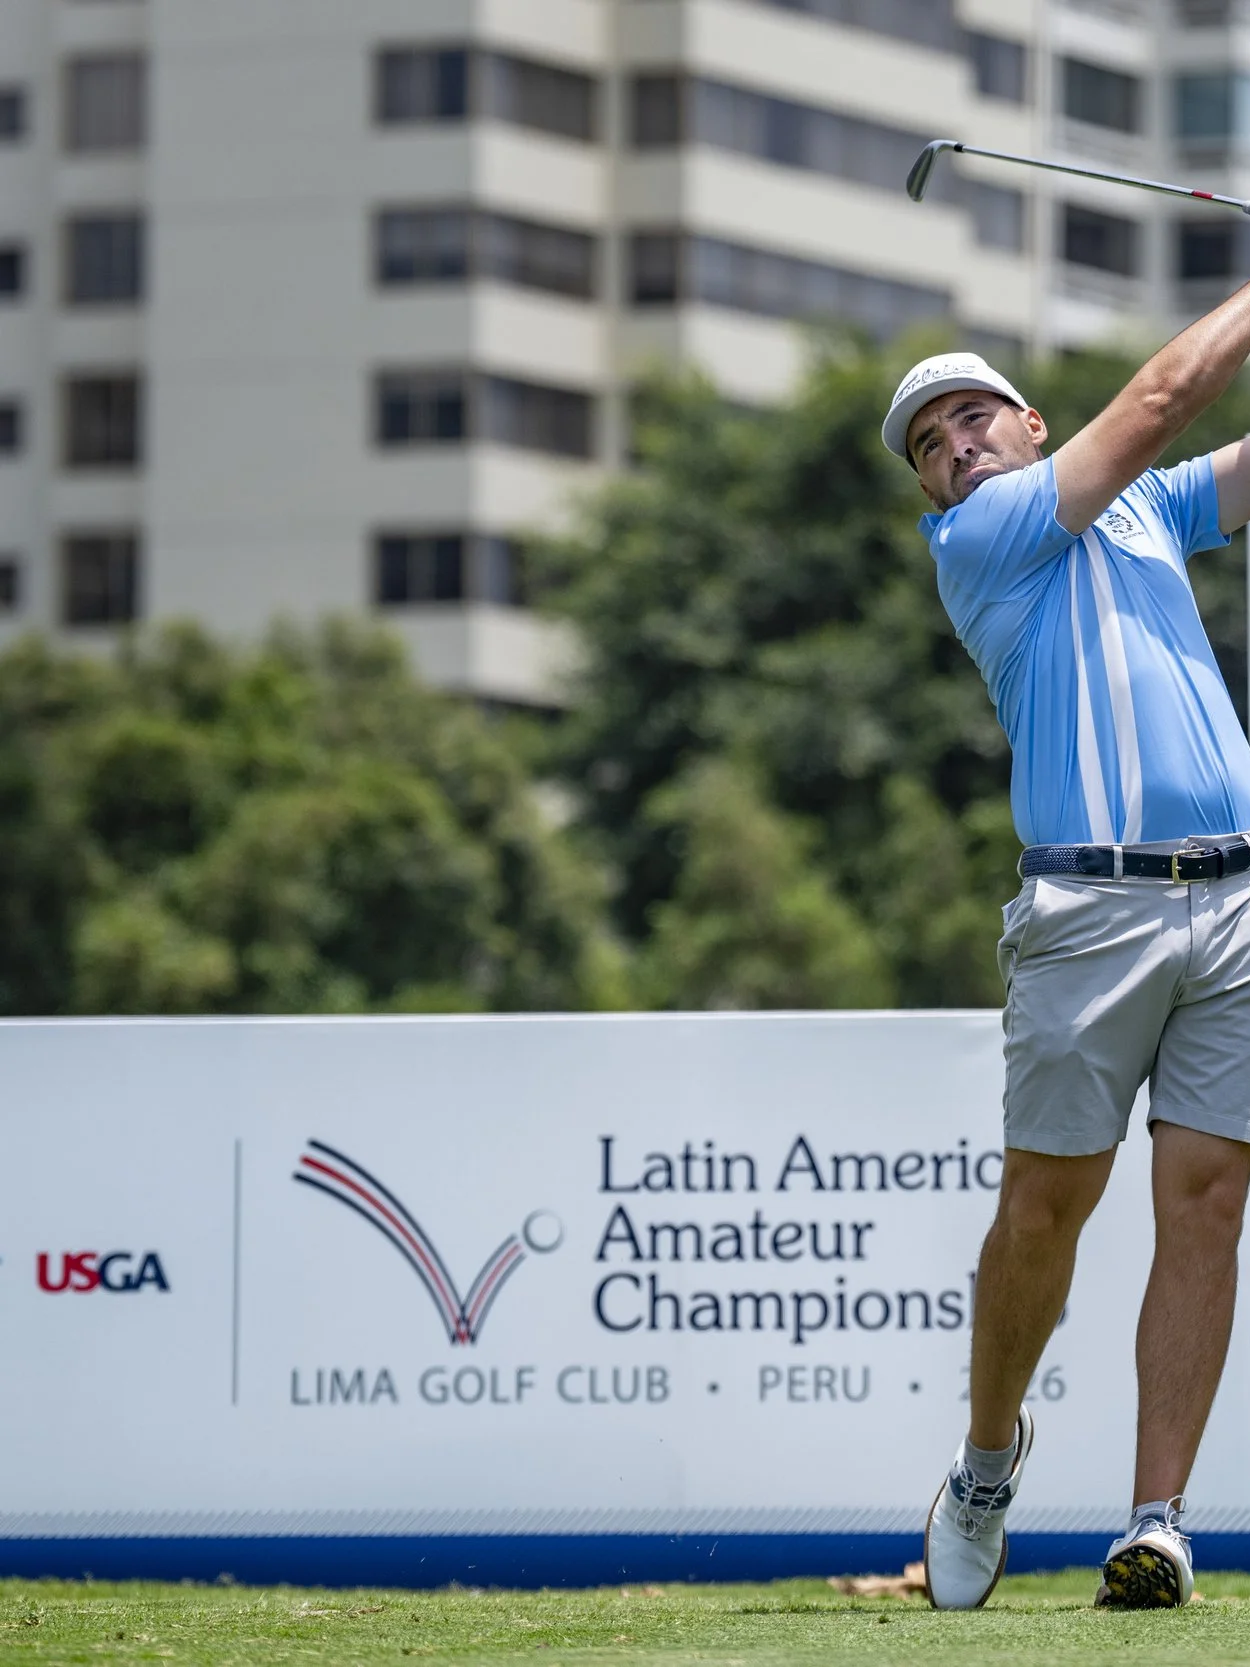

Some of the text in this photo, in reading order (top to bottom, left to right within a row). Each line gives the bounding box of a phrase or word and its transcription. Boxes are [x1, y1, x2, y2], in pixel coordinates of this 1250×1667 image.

[598, 1135, 1003, 1193] Latin Americ
[595, 1204, 875, 1262] Amateur
[36, 1252, 170, 1293] USGA
[592, 1272, 1068, 1344] Champions
[290, 1365, 871, 1405] LIMA GOLF CLUB PERU
